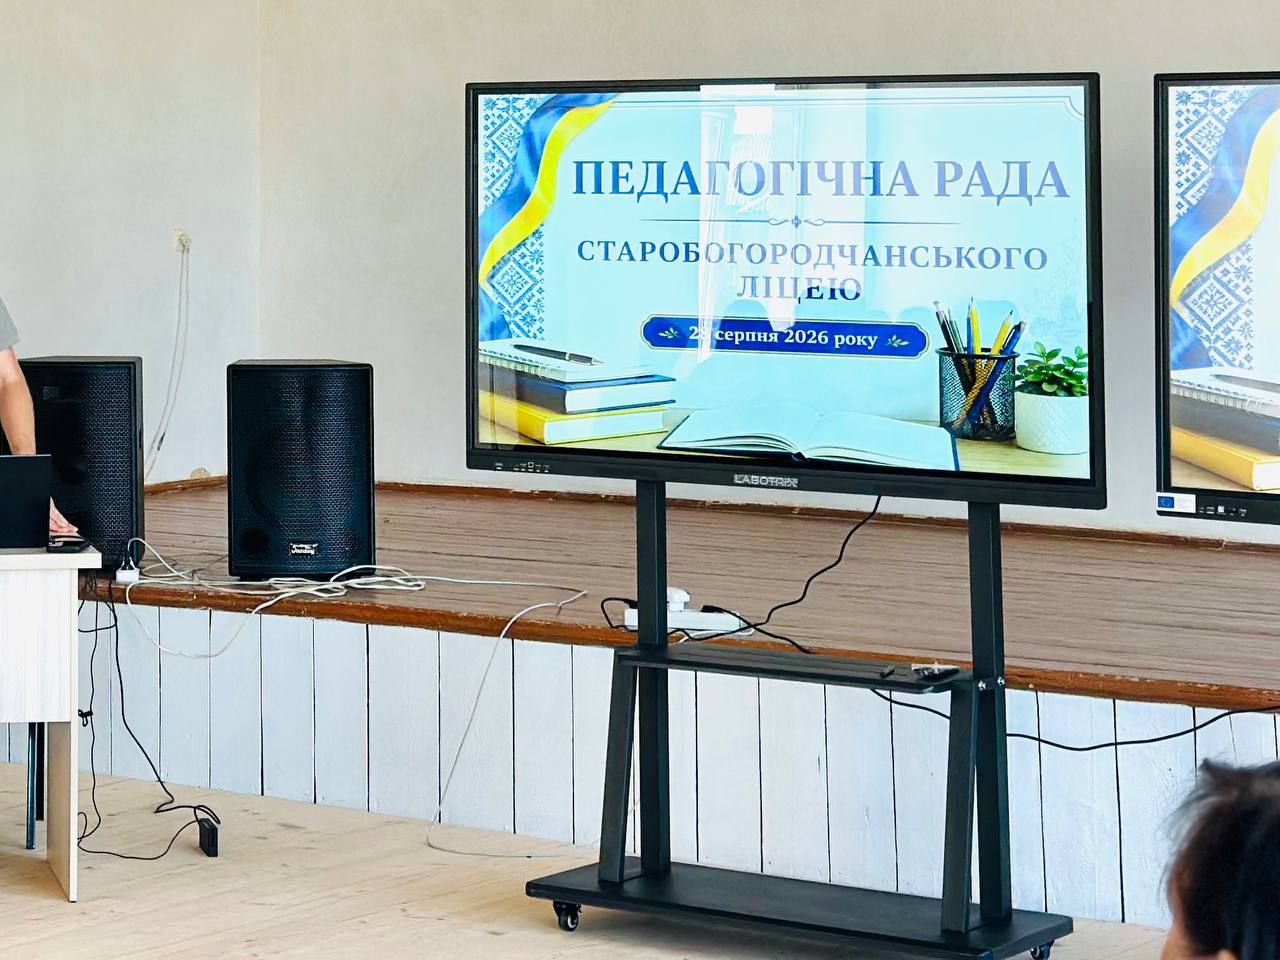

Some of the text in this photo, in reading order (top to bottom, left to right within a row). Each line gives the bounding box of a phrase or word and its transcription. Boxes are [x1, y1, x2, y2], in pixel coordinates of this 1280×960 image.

[573, 160, 1070, 206] ПЕДАГОГІЧНА РАДА
[577, 240, 1048, 271] СТАРОБОГОРОДЧАНСЬКОГО
[737, 275, 862, 304] ЛІЦЕЮ
[715, 329, 778, 346] серпня
[784, 329, 829, 345] 2026
[835, 334, 878, 349] року
